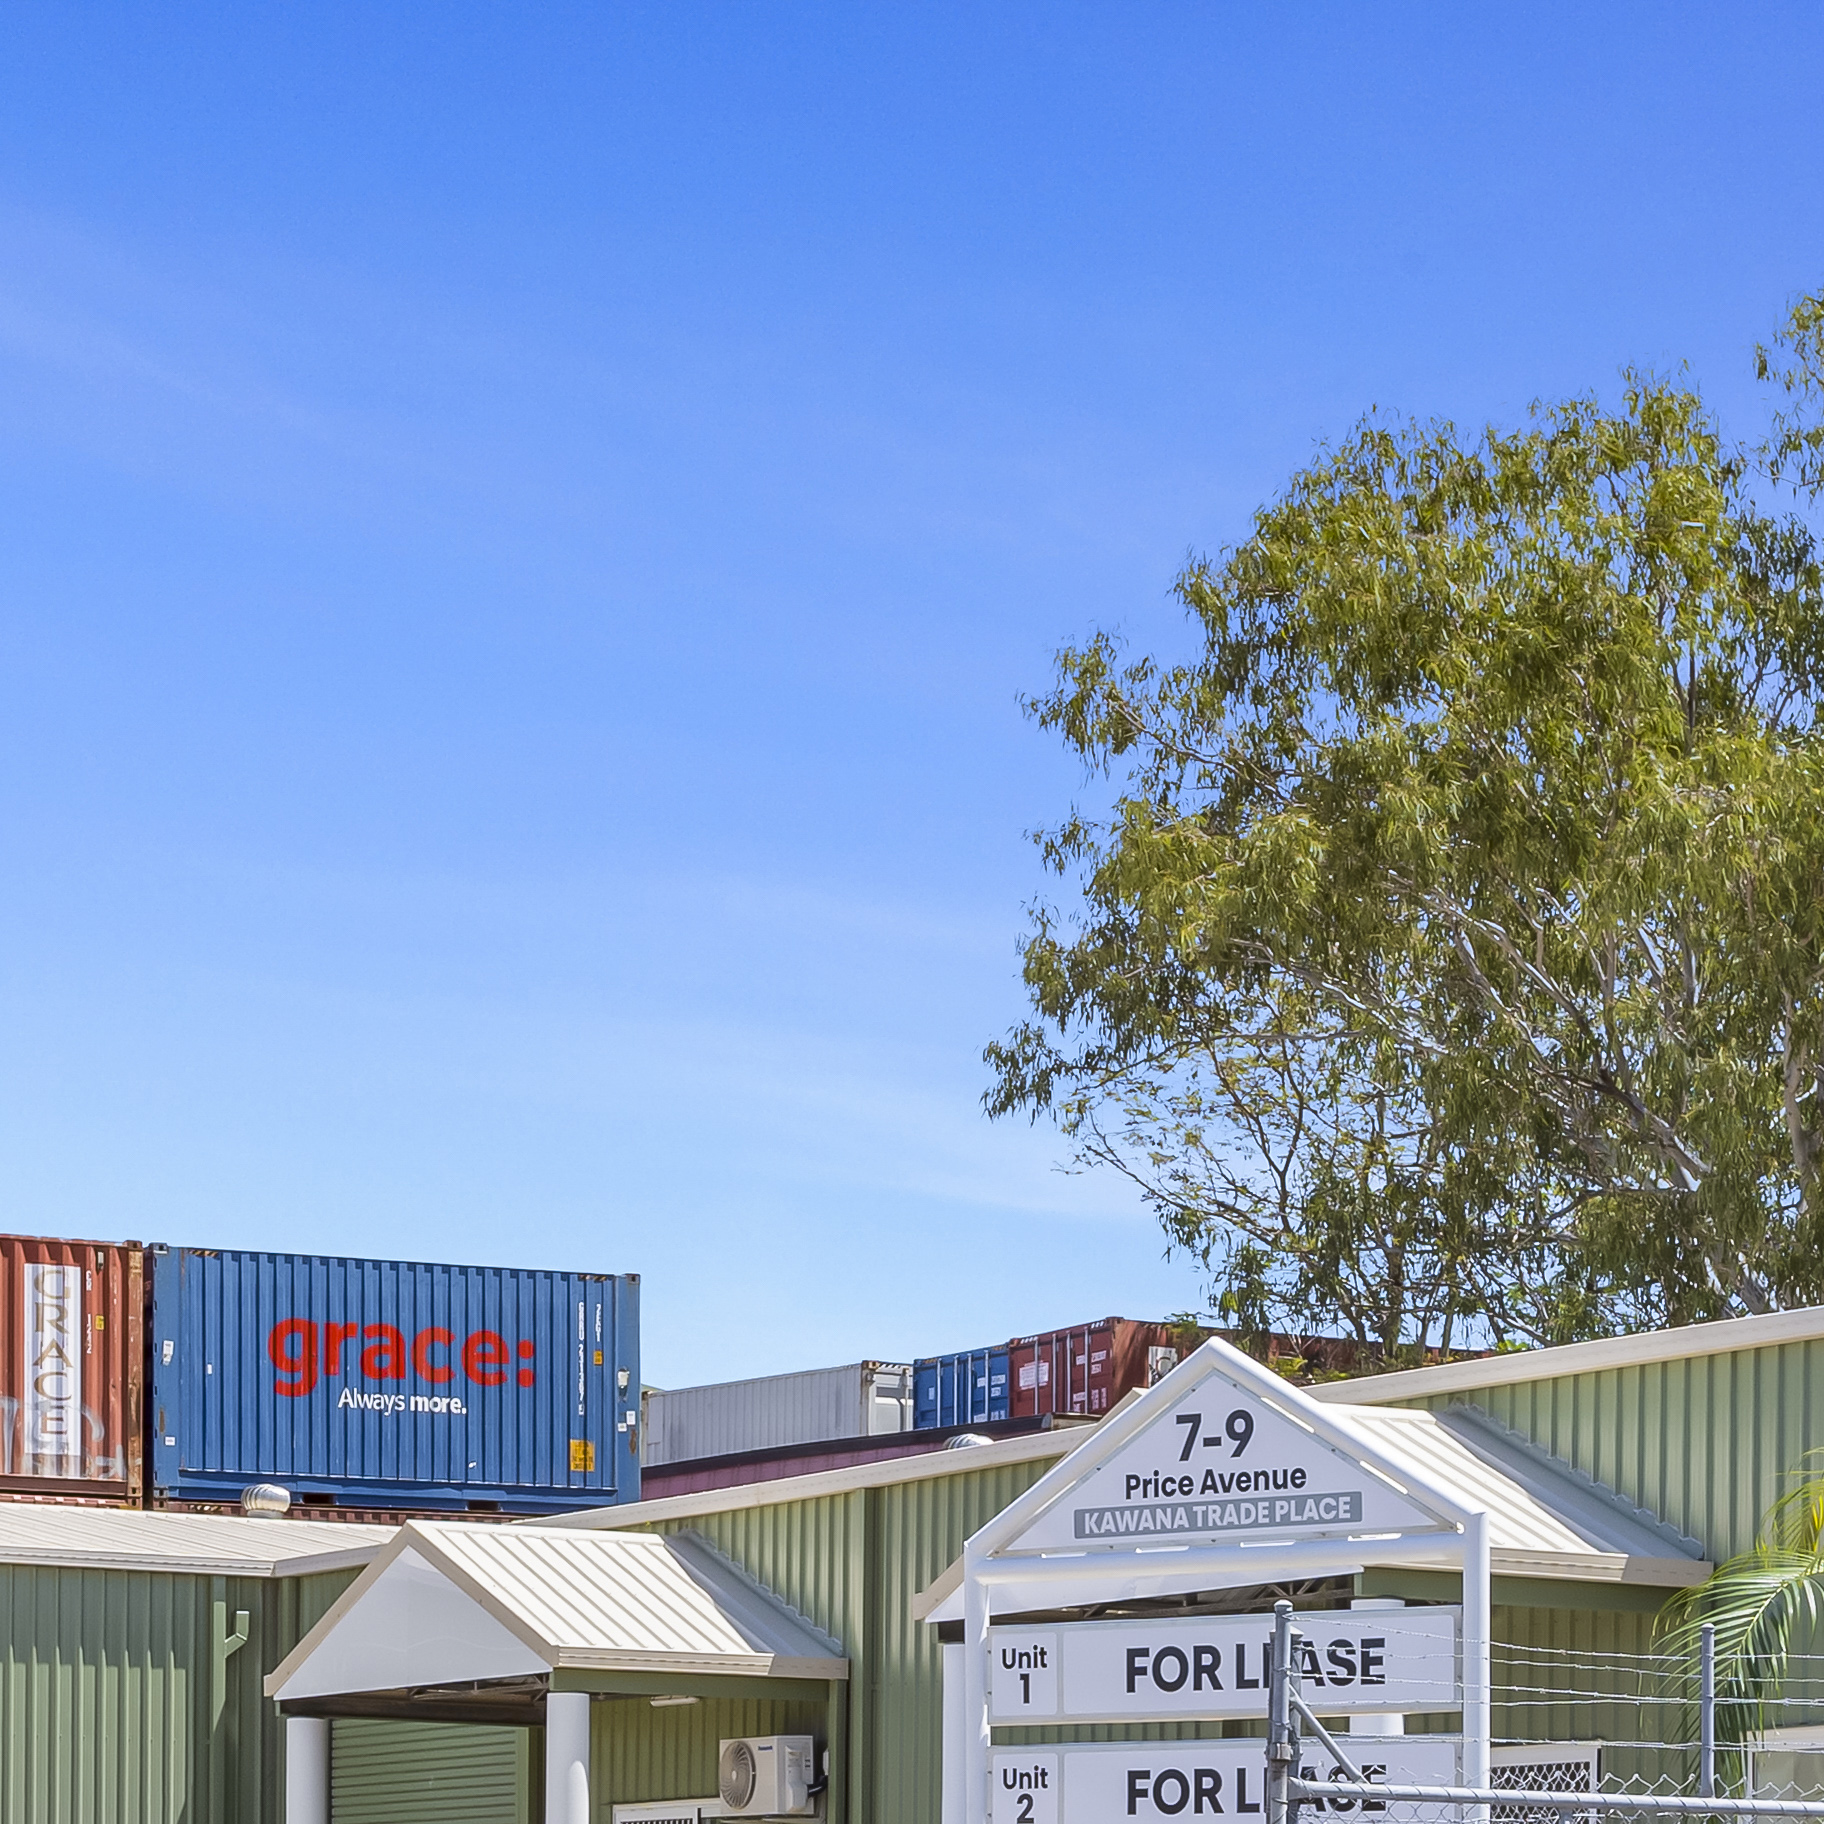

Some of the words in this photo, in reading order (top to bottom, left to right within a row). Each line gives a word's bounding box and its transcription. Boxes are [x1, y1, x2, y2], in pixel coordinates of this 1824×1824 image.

[32, 1269, 74, 1435] GRACE
[337, 1387, 406, 1417] Always
[409, 1395, 468, 1415] more.
[1175, 1409, 1255, 1462] 7-9
[1125, 1469, 1194, 1500] Price
[1200, 1467, 1307, 1496] Avenue
[1084, 1507, 1189, 1535] KAWANA
[1192, 1501, 1270, 1528] TRADE
[1275, 1496, 1352, 1523] PLACE
[1002, 1645, 1048, 1670] Unit
[1126, 1645, 1224, 1693] FOR
[1019, 1673, 1030, 1704] 1
[1002, 1766, 1049, 1790] Unit
[1127, 1768, 1225, 1816] FOR
[1016, 1794, 1035, 1824] 2
